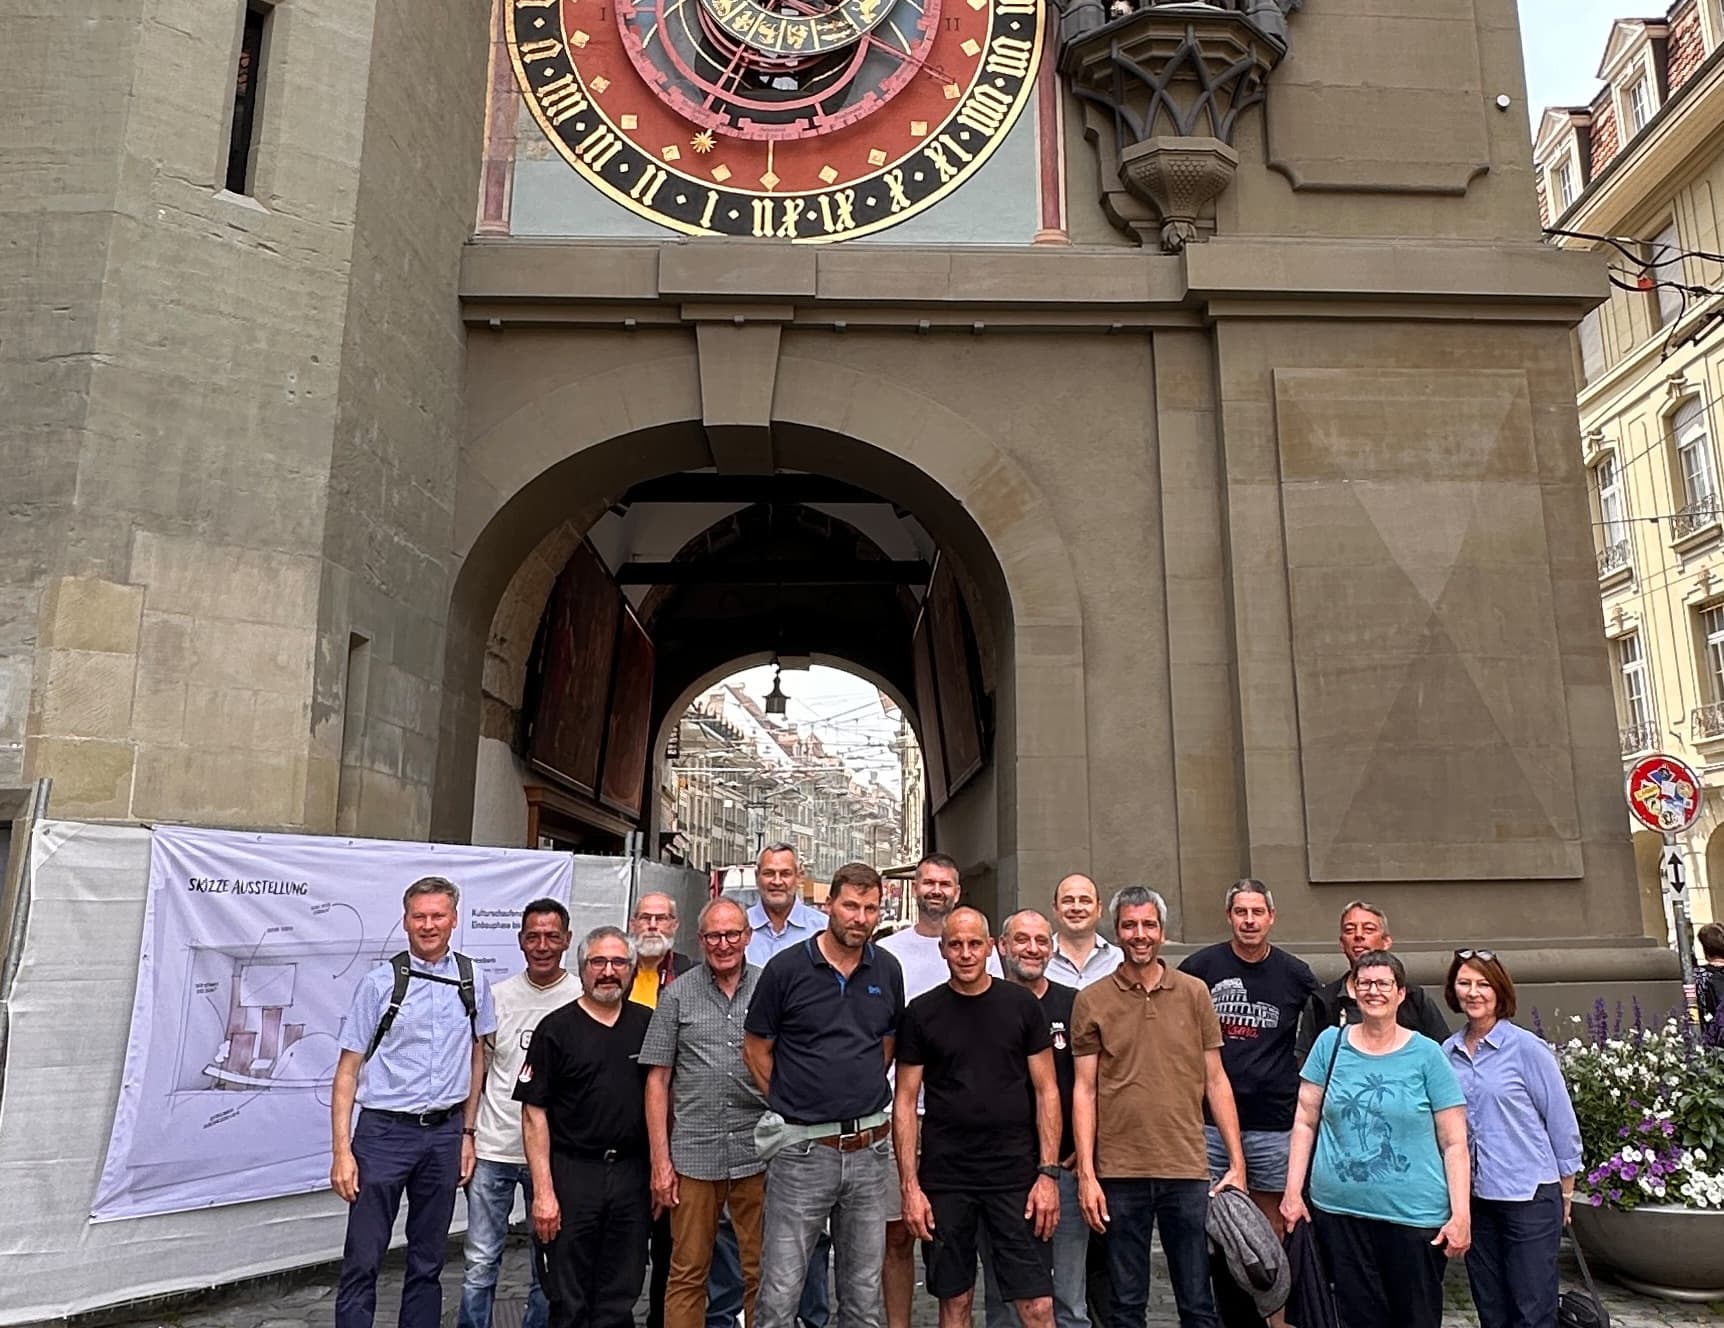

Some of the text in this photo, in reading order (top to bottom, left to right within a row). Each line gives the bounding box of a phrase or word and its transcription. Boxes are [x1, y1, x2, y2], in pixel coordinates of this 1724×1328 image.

[536, 72, 588, 126] IIII
[575, 124, 623, 172] III
[629, 163, 668, 207] II
[883, 168, 911, 213] X
[700, 190, 719, 228] I
[231, 878, 309, 896] AUSSTELLUNG
